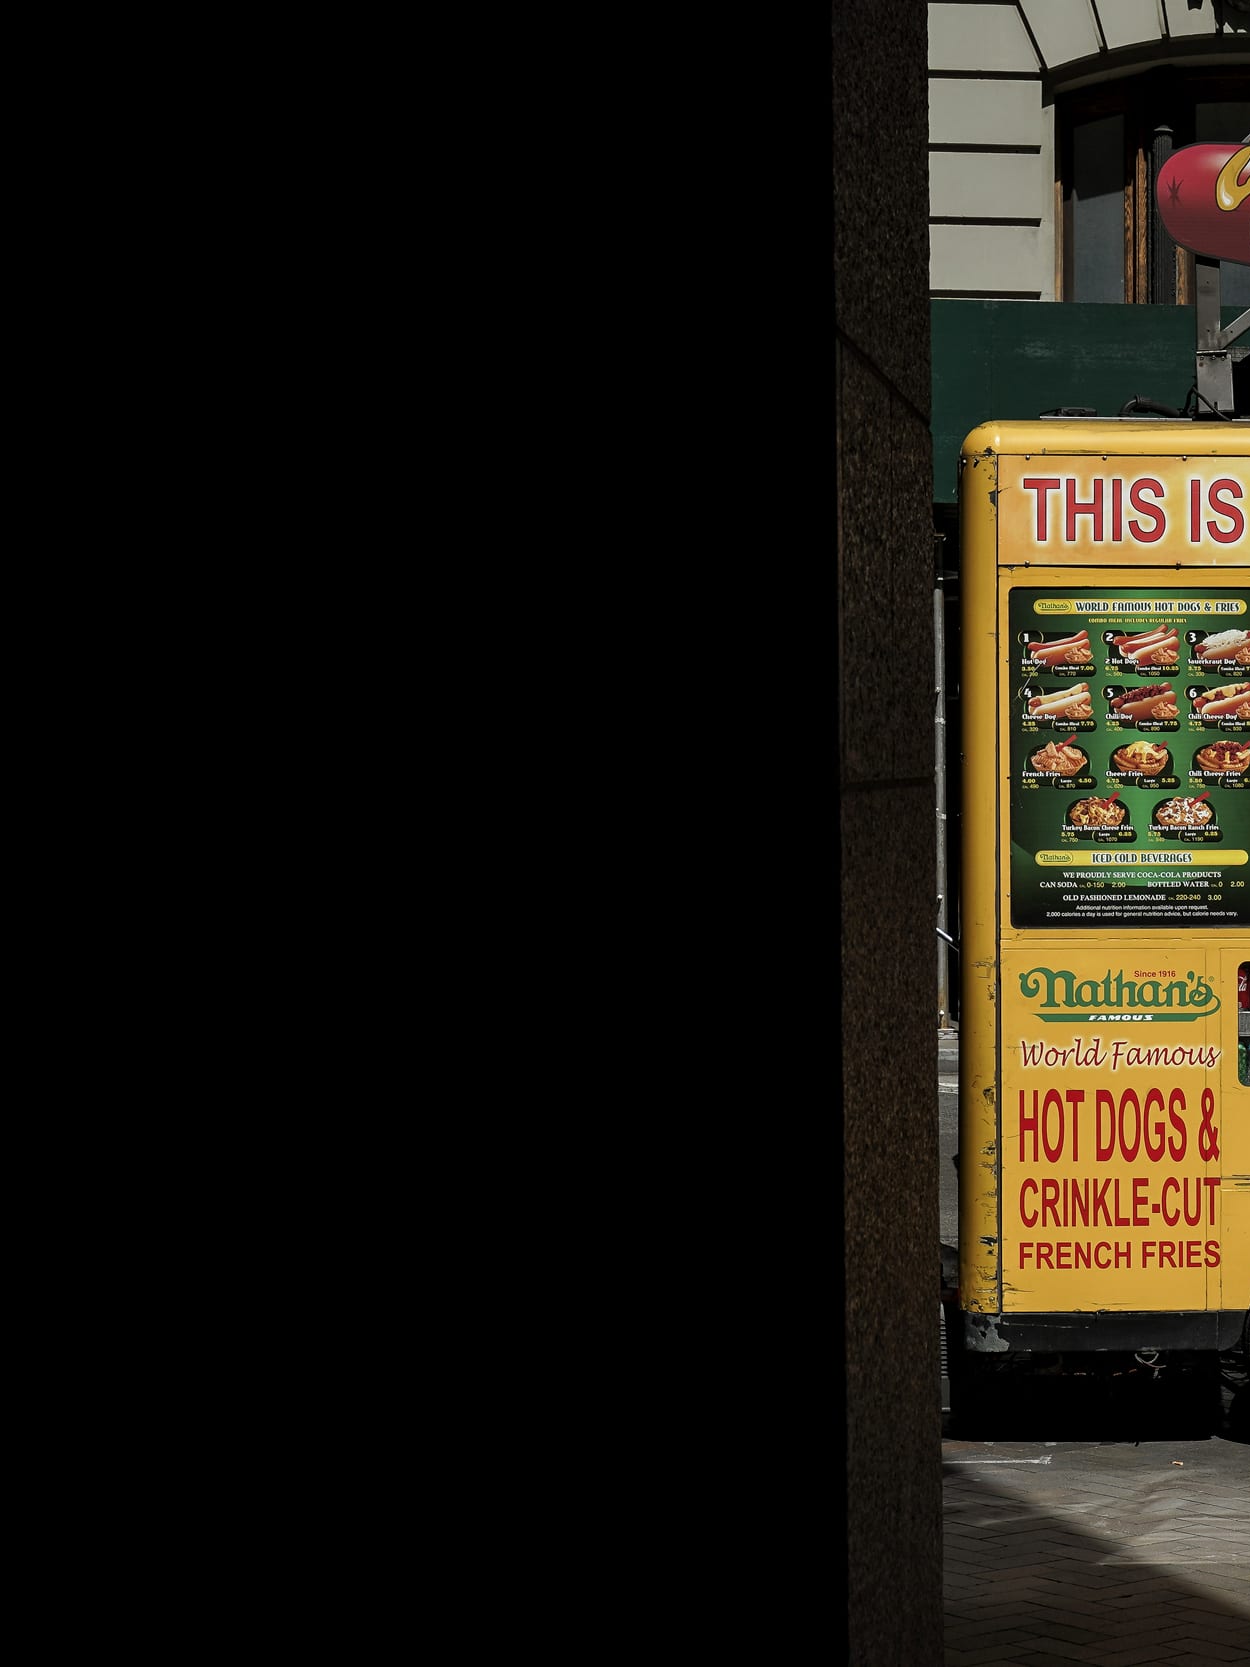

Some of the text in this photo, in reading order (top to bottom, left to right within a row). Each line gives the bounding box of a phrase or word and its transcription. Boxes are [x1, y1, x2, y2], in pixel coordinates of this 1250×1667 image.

[1023, 477, 1167, 543] THIS
[1190, 478, 1245, 544] IS
[1075, 602, 1109, 612] WORLD
[1112, 602, 1152, 612] FAMOUS
[1154, 602, 1174, 612] HOT
[1177, 602, 1201, 612] DOGS
[1204, 602, 1212, 612] &
[1215, 602, 1240, 612] FRIES
[1022, 633, 1030, 642] 1
[1105, 632, 1114, 642] 2
[1189, 632, 1197, 642] 3
[1024, 688, 1032, 698] 4
[1106, 688, 1114, 698] 5
[1189, 688, 1197, 698] 6
[1092, 853, 1112, 863] ICED
[1114, 853, 1138, 863] COLD
[1140, 853, 1192, 863] BEVERAGES
[1134, 970, 1176, 978] Since 1916
[1018, 966, 1217, 1008] Nathan's
[1088, 1014, 1154, 1022] FAMOUS
[1021, 1038, 1221, 1070] World Famous
[1019, 1087, 1220, 1162] HOT DOGS &
[1019, 1176, 1222, 1228] CRINKLE-CUT
[1019, 1240, 1222, 1270] FRENCH FRIES
